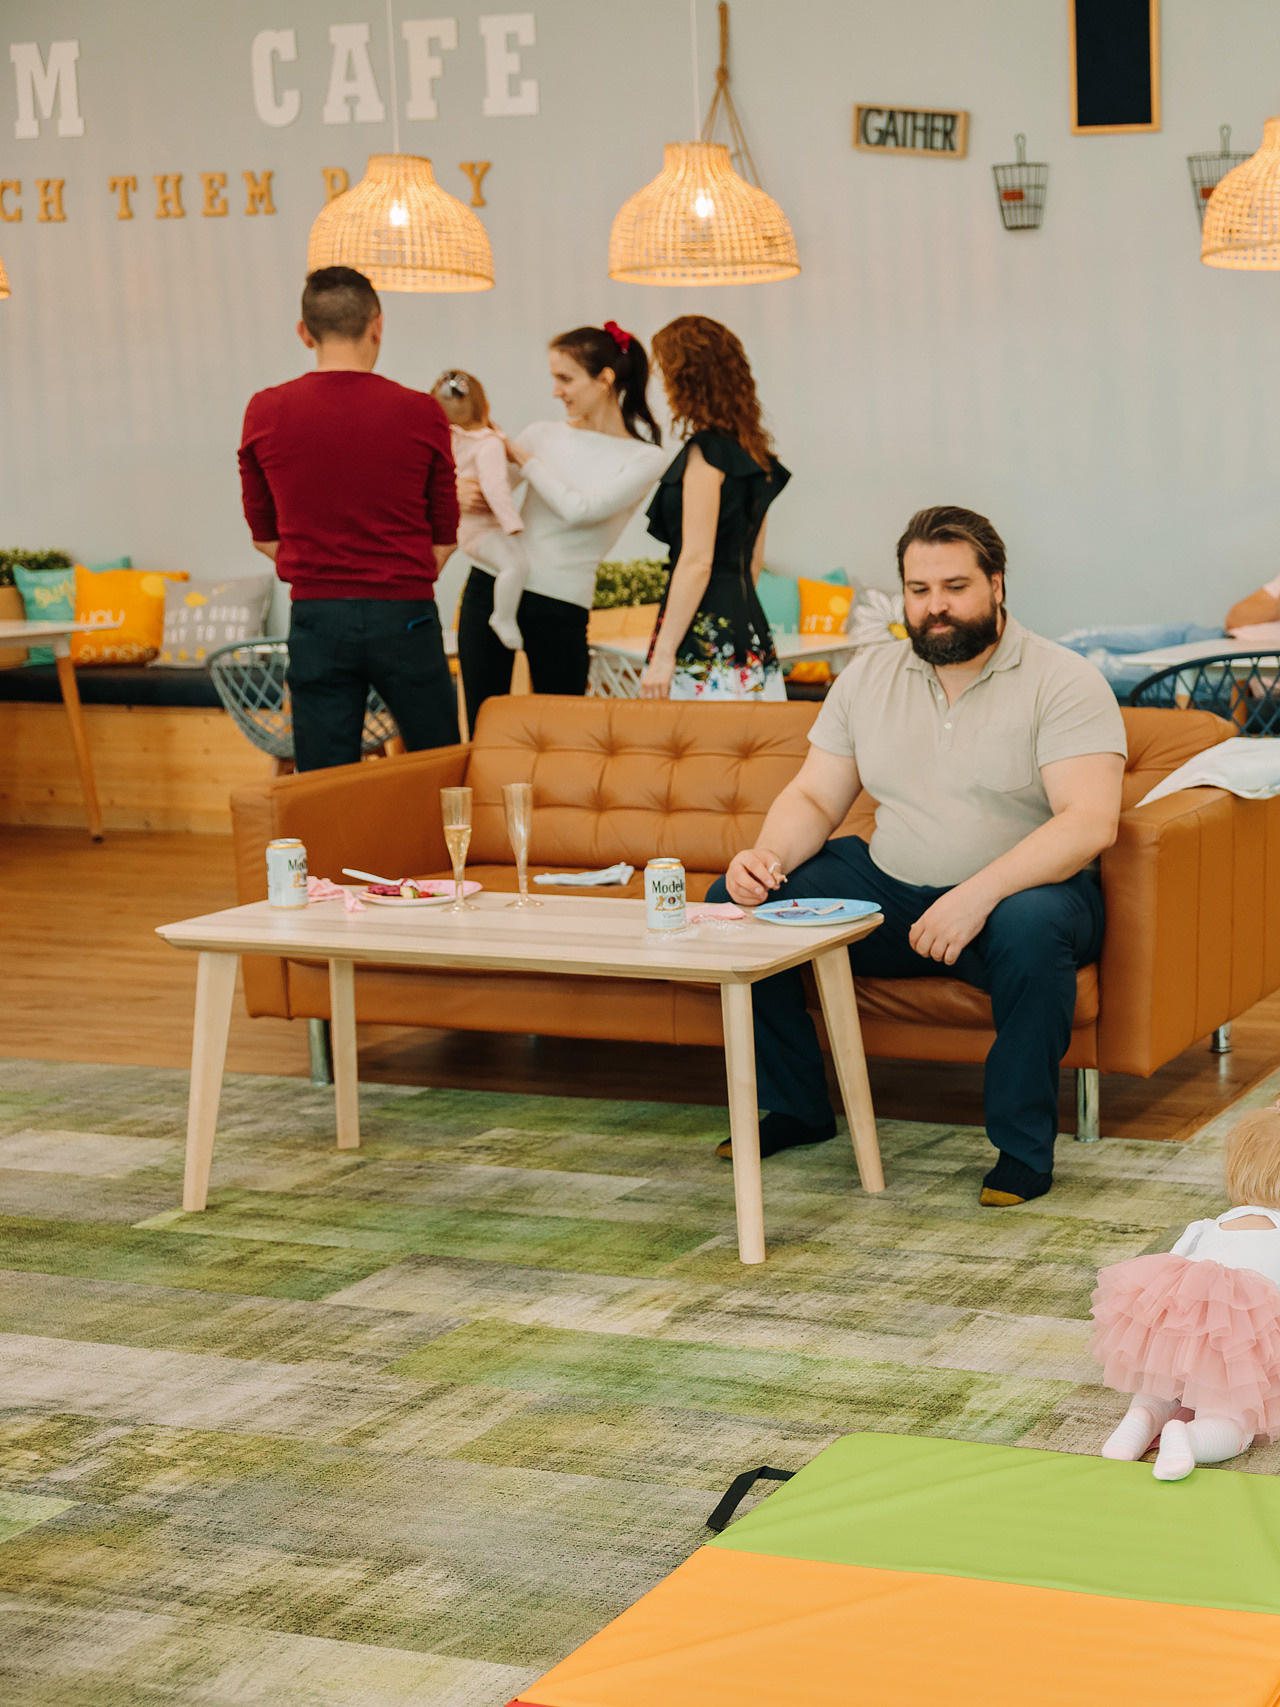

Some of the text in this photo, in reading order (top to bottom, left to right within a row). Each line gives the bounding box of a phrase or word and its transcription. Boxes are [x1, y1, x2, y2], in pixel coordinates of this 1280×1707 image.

[251, 13, 539, 127] CAFE
[861, 108, 957, 151] GATHER
[108, 171, 277, 220] THEM
[322, 161, 492, 208] PY
[652, 879, 685, 894] Model
